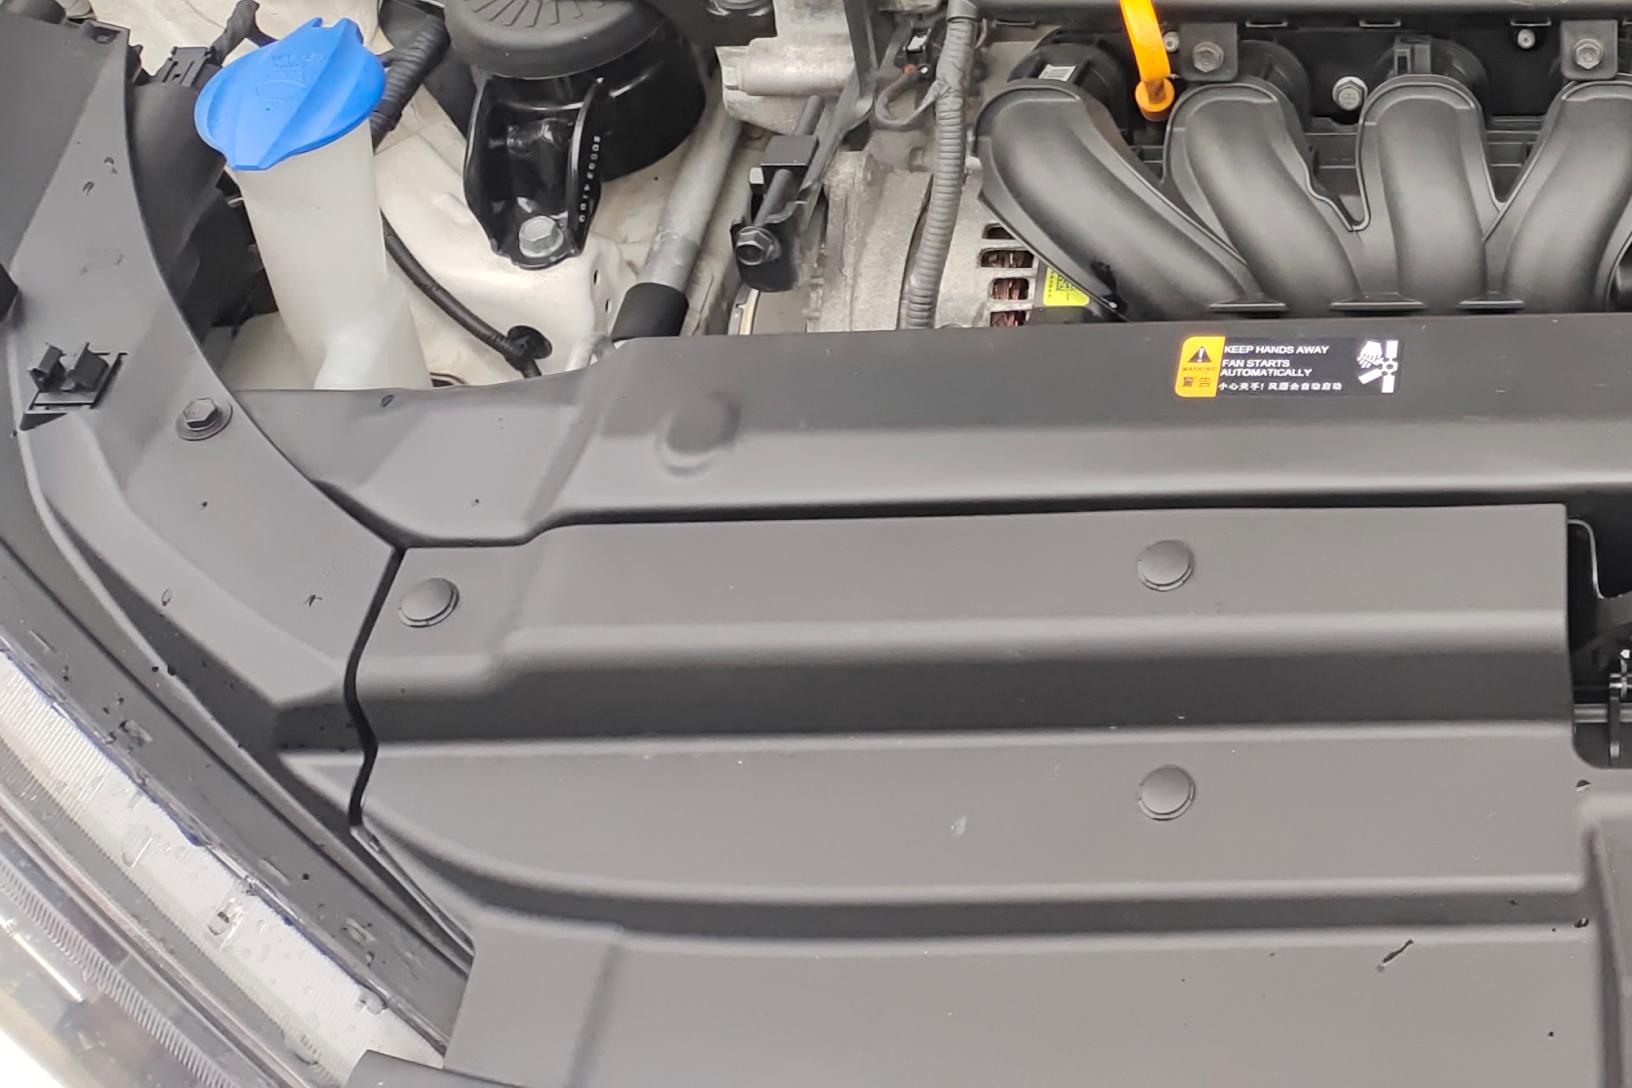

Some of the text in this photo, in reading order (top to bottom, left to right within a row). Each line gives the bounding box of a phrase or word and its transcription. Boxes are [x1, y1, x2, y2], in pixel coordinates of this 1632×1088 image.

[1224, 344, 1330, 355] KEEP HANDS AWAY
[1222, 359, 1291, 368] FAN STARTS
[1220, 368, 1312, 378] AUTOMATICALLY
